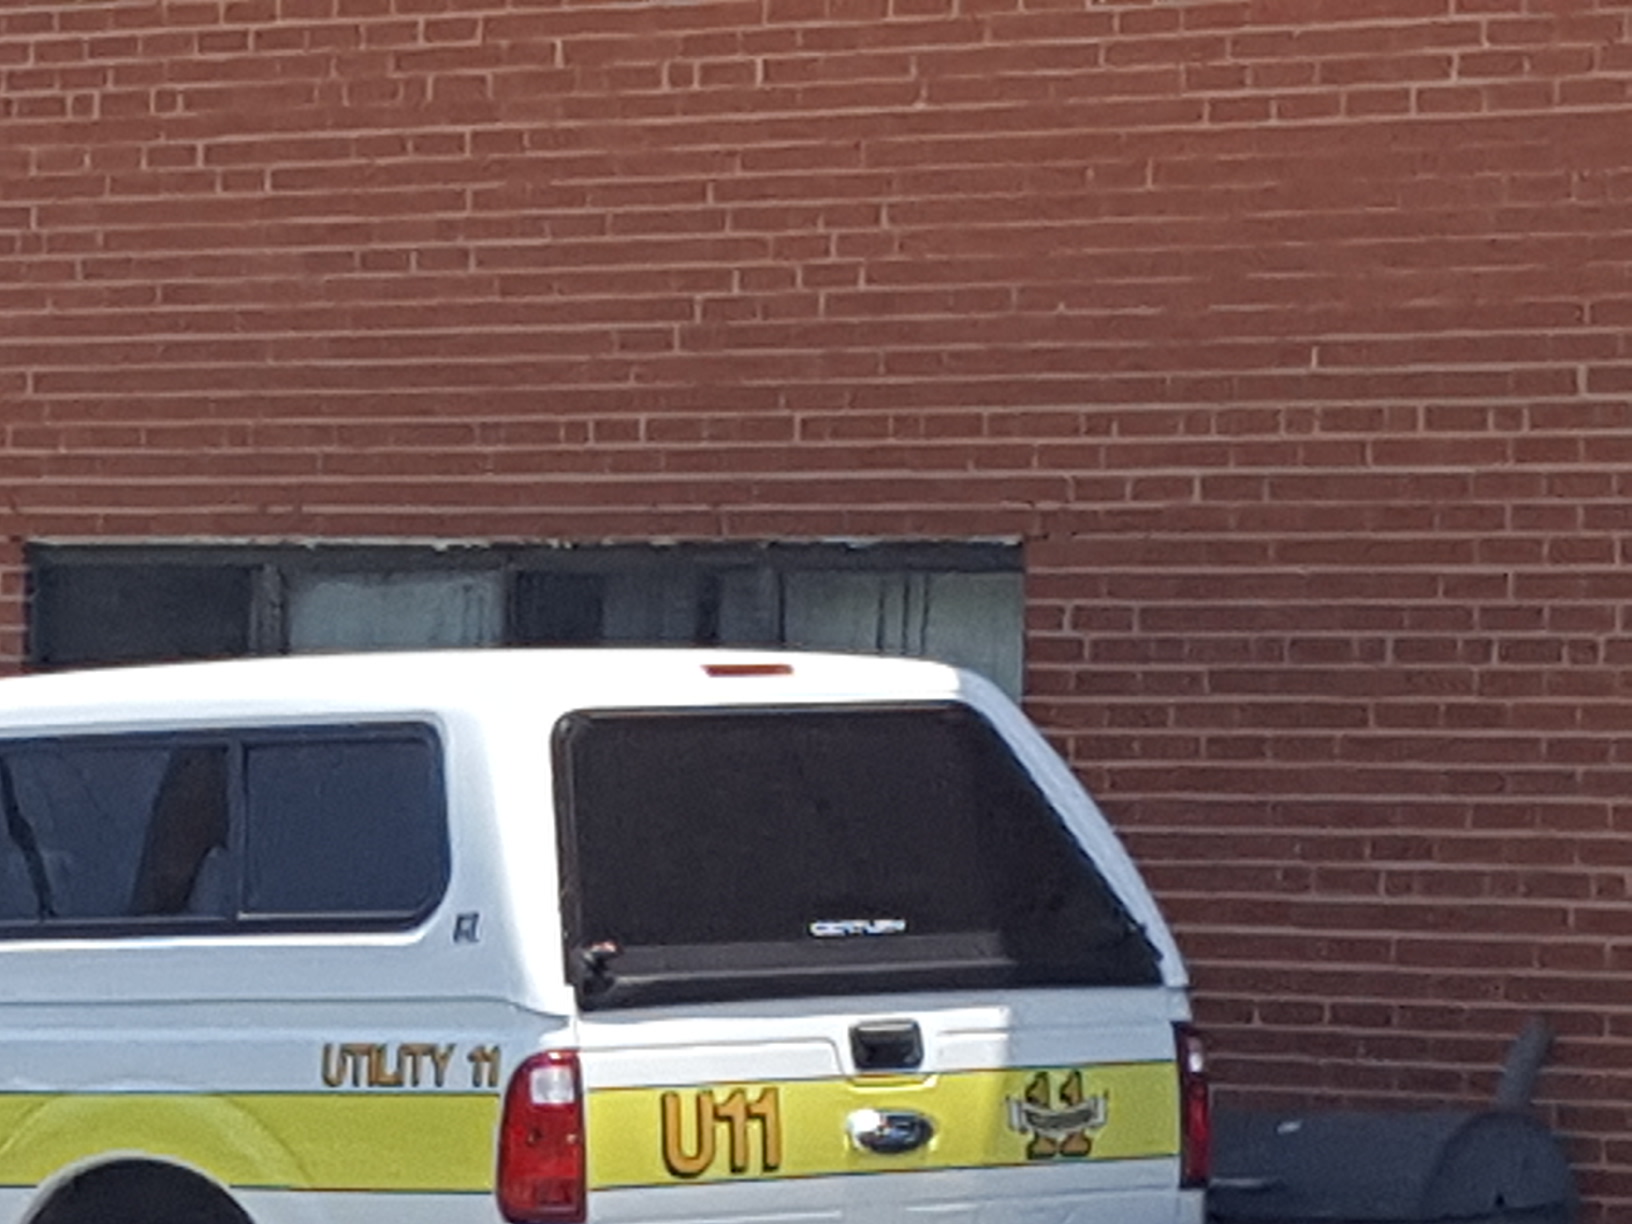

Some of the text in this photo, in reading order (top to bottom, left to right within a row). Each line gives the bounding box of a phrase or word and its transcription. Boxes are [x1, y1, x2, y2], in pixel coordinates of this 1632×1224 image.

[321, 1042, 502, 1088] UTILITY 11
[659, 1086, 782, 1179] U11
